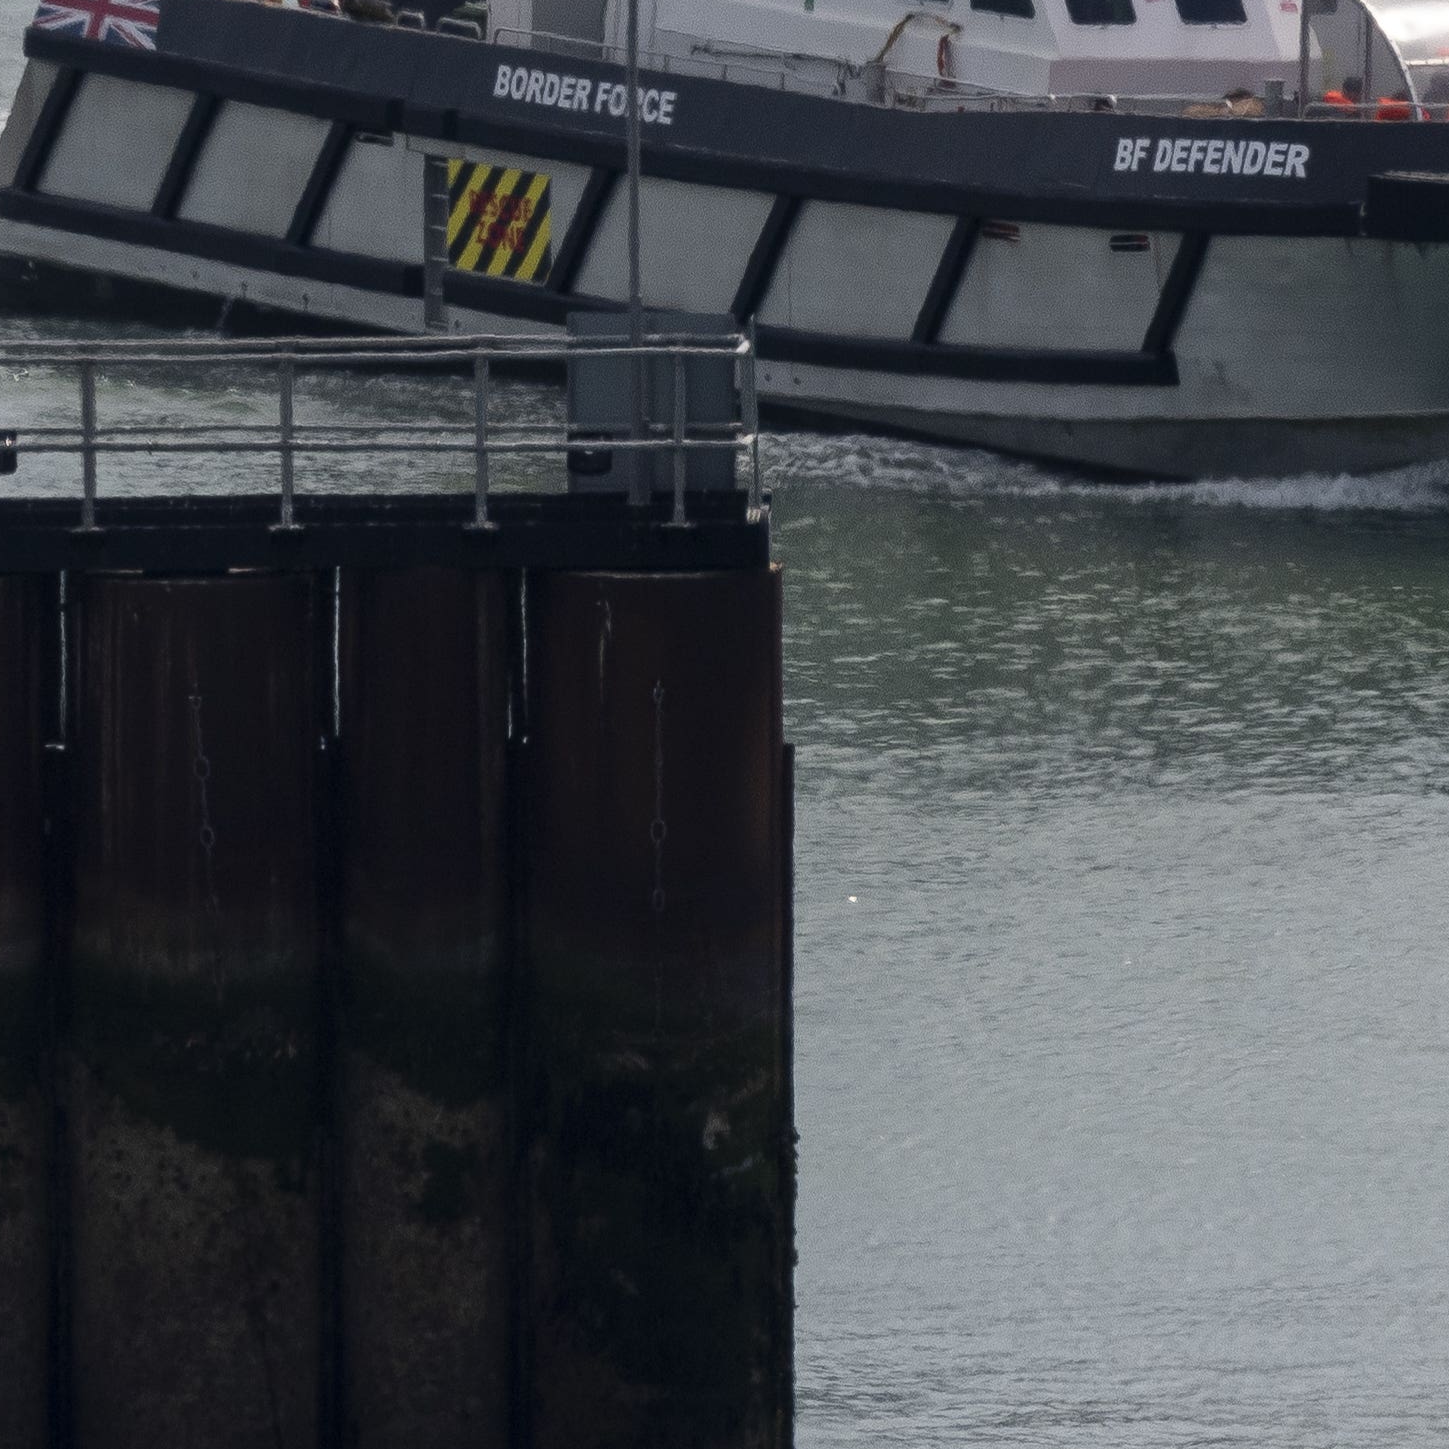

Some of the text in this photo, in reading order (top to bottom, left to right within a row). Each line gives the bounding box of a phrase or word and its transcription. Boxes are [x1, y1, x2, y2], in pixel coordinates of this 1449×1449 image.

[493, 65, 591, 111] BORDER
[1113, 137, 1310, 178] BF DEFENDER
